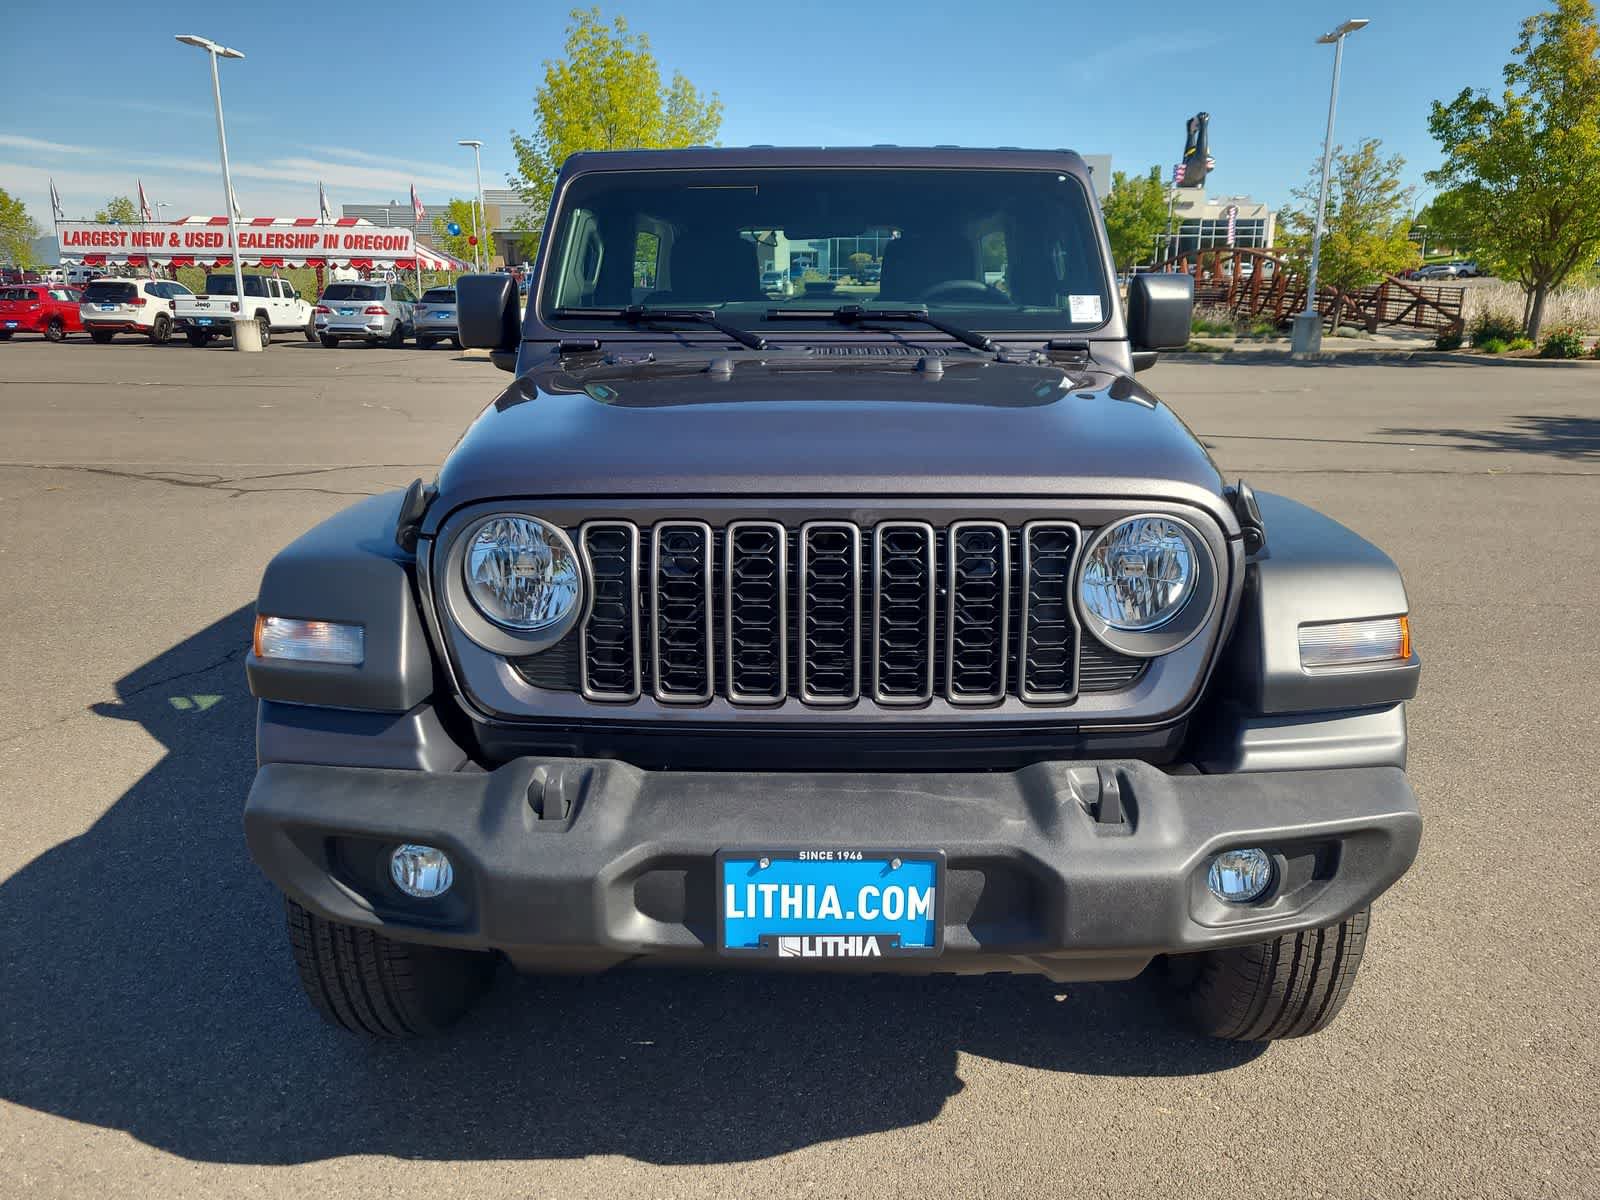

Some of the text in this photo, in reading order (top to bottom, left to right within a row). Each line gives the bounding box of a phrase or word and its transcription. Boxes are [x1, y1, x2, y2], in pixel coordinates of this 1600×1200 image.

[63, 231, 128, 247] LARGEST
[131, 231, 165, 248] NEW
[168, 232, 181, 248] &
[184, 232, 224, 248] USED
[323, 233, 339, 249] IN
[343, 233, 410, 251] OREGON!
[799, 851, 863, 860] SINCE 1946
[726, 883, 937, 921] LITHIA.COM
[802, 936, 882, 957] LITHIA
